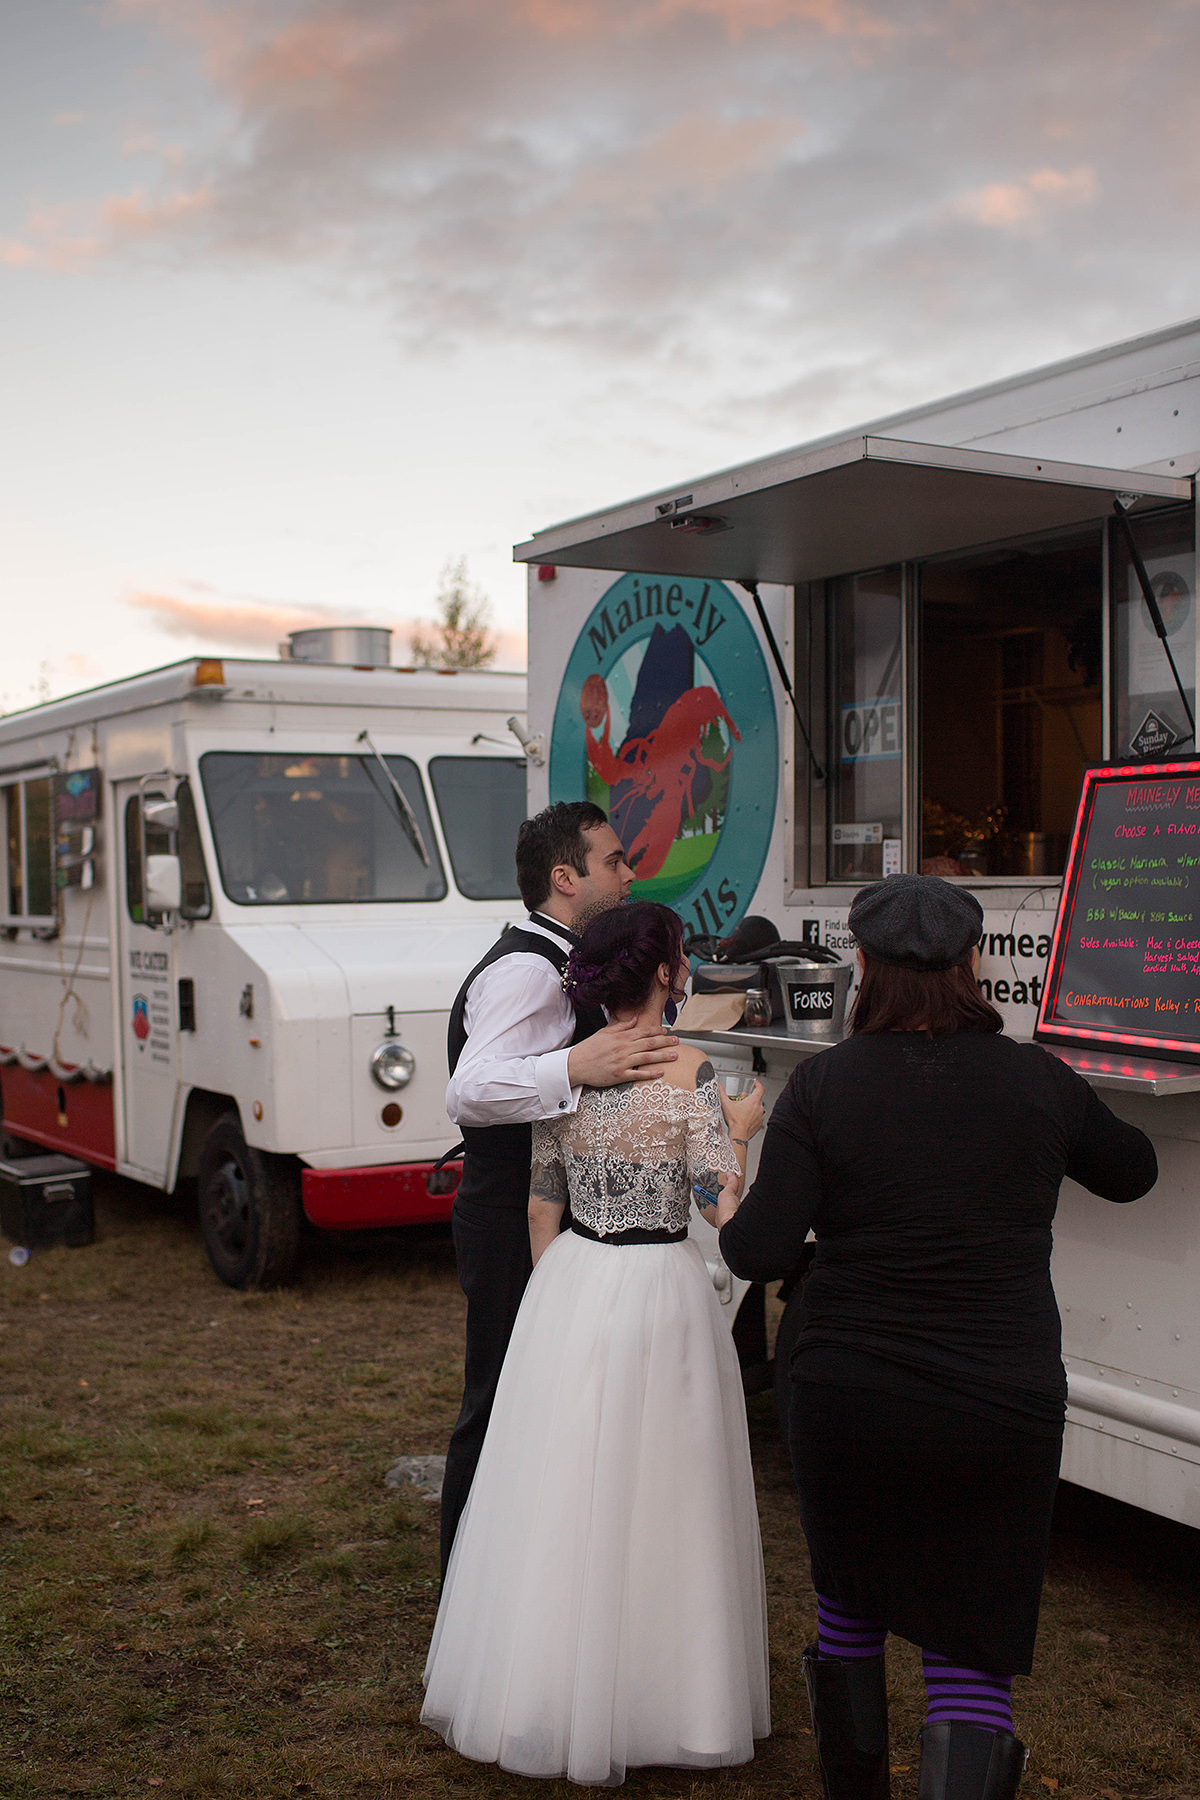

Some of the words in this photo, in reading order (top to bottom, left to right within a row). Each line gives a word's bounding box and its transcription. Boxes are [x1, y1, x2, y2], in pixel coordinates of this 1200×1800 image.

[587, 579, 726, 665] Maine-ly
[1138, 731, 1168, 747] Sunday
[1126, 786, 1181, 807] MAINE-LY
[1114, 824, 1147, 838] Choose
[1153, 825, 1160, 835] A
[1168, 911, 1194, 923] Sauce
[825, 919, 841, 930] Find
[1080, 937, 1100, 949] Sides
[1146, 936, 1163, 950] Mac
[1143, 951, 1174, 962] Harvest
[1177, 951, 1200, 963] Salad
[1142, 964, 1168, 973] Candied
[793, 991, 833, 1010] FORKS
